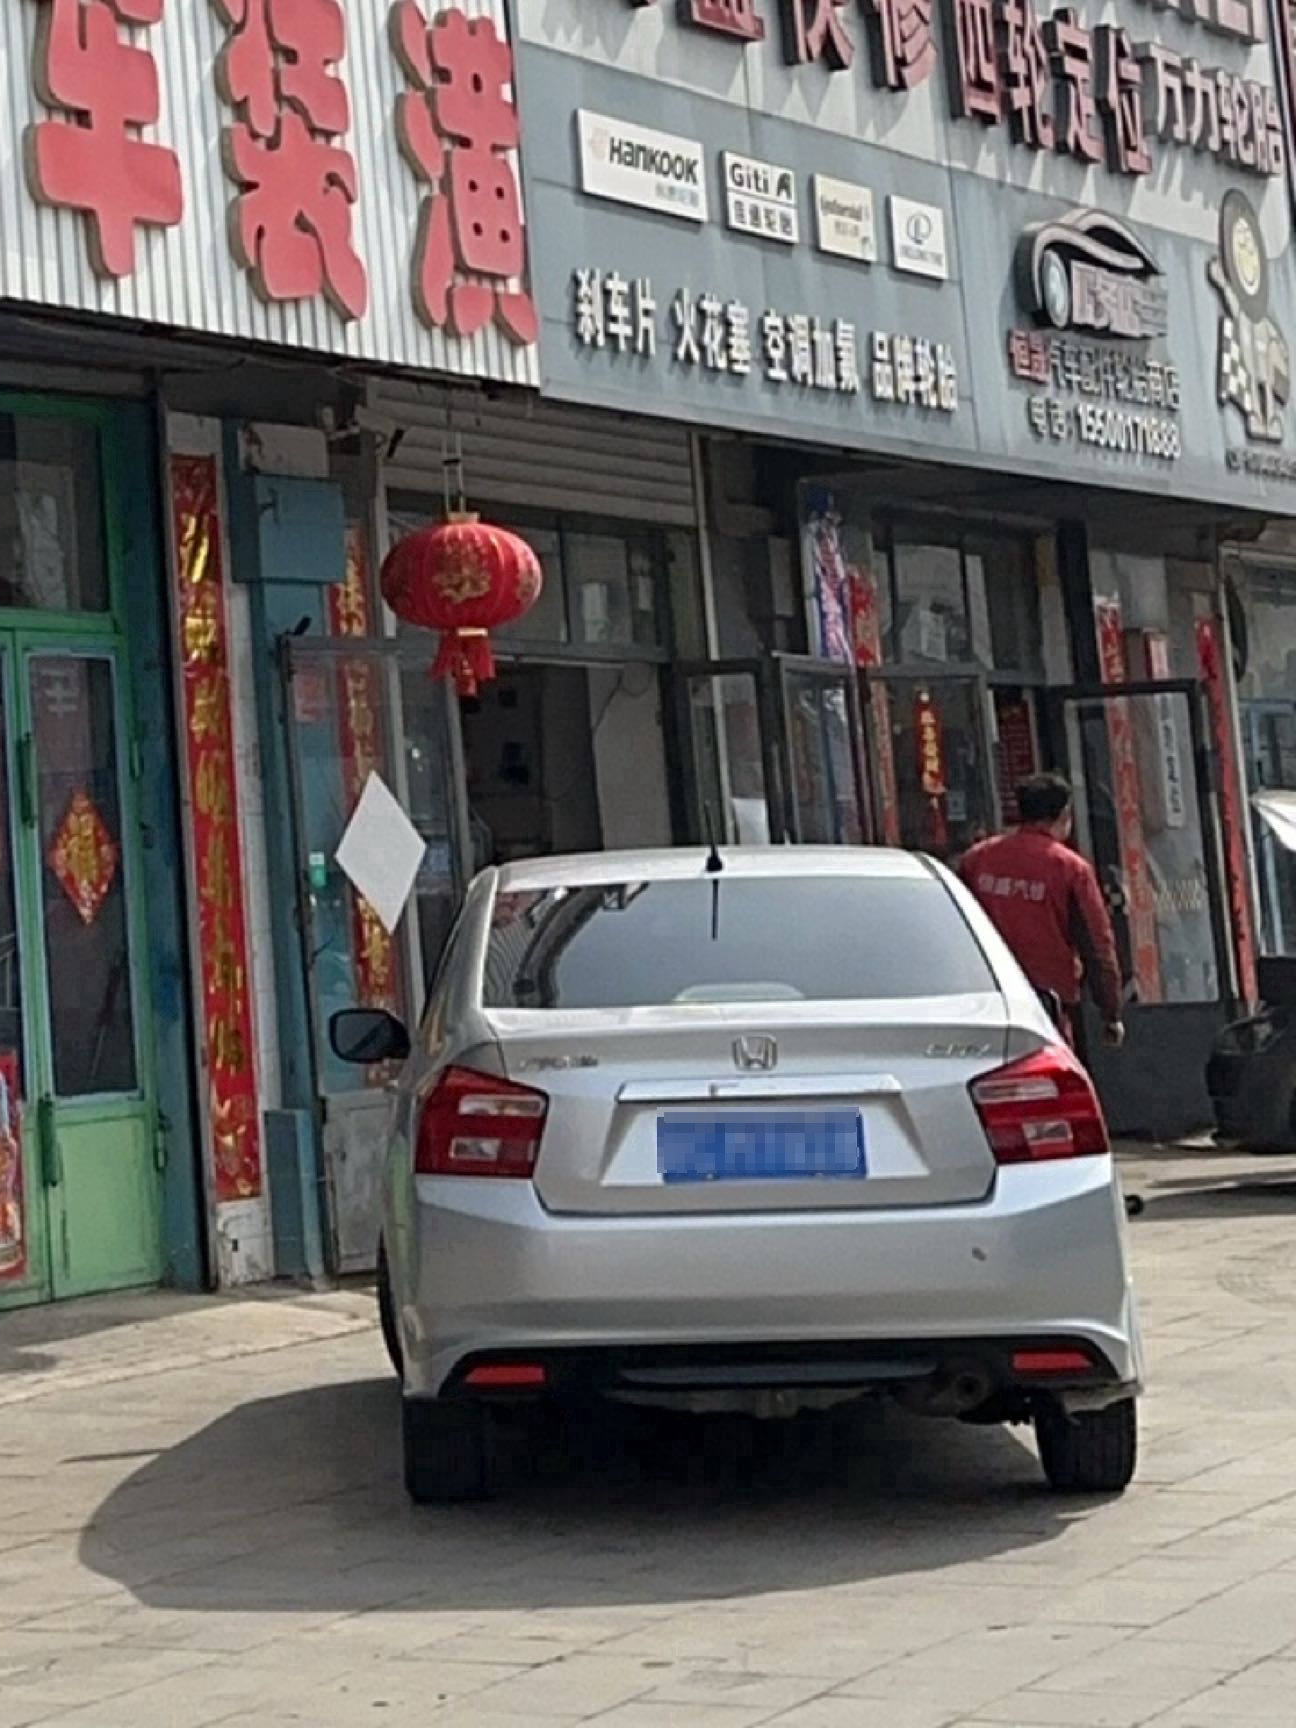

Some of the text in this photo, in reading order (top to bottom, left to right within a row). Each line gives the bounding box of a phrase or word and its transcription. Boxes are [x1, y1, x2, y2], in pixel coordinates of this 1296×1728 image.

[1134, 42, 1284, 177] 万力轮胎
[730, 163, 770, 195] Giti
[576, 267, 958, 412] 刹车片 火花塞 空调加氟 品牌轮胎
